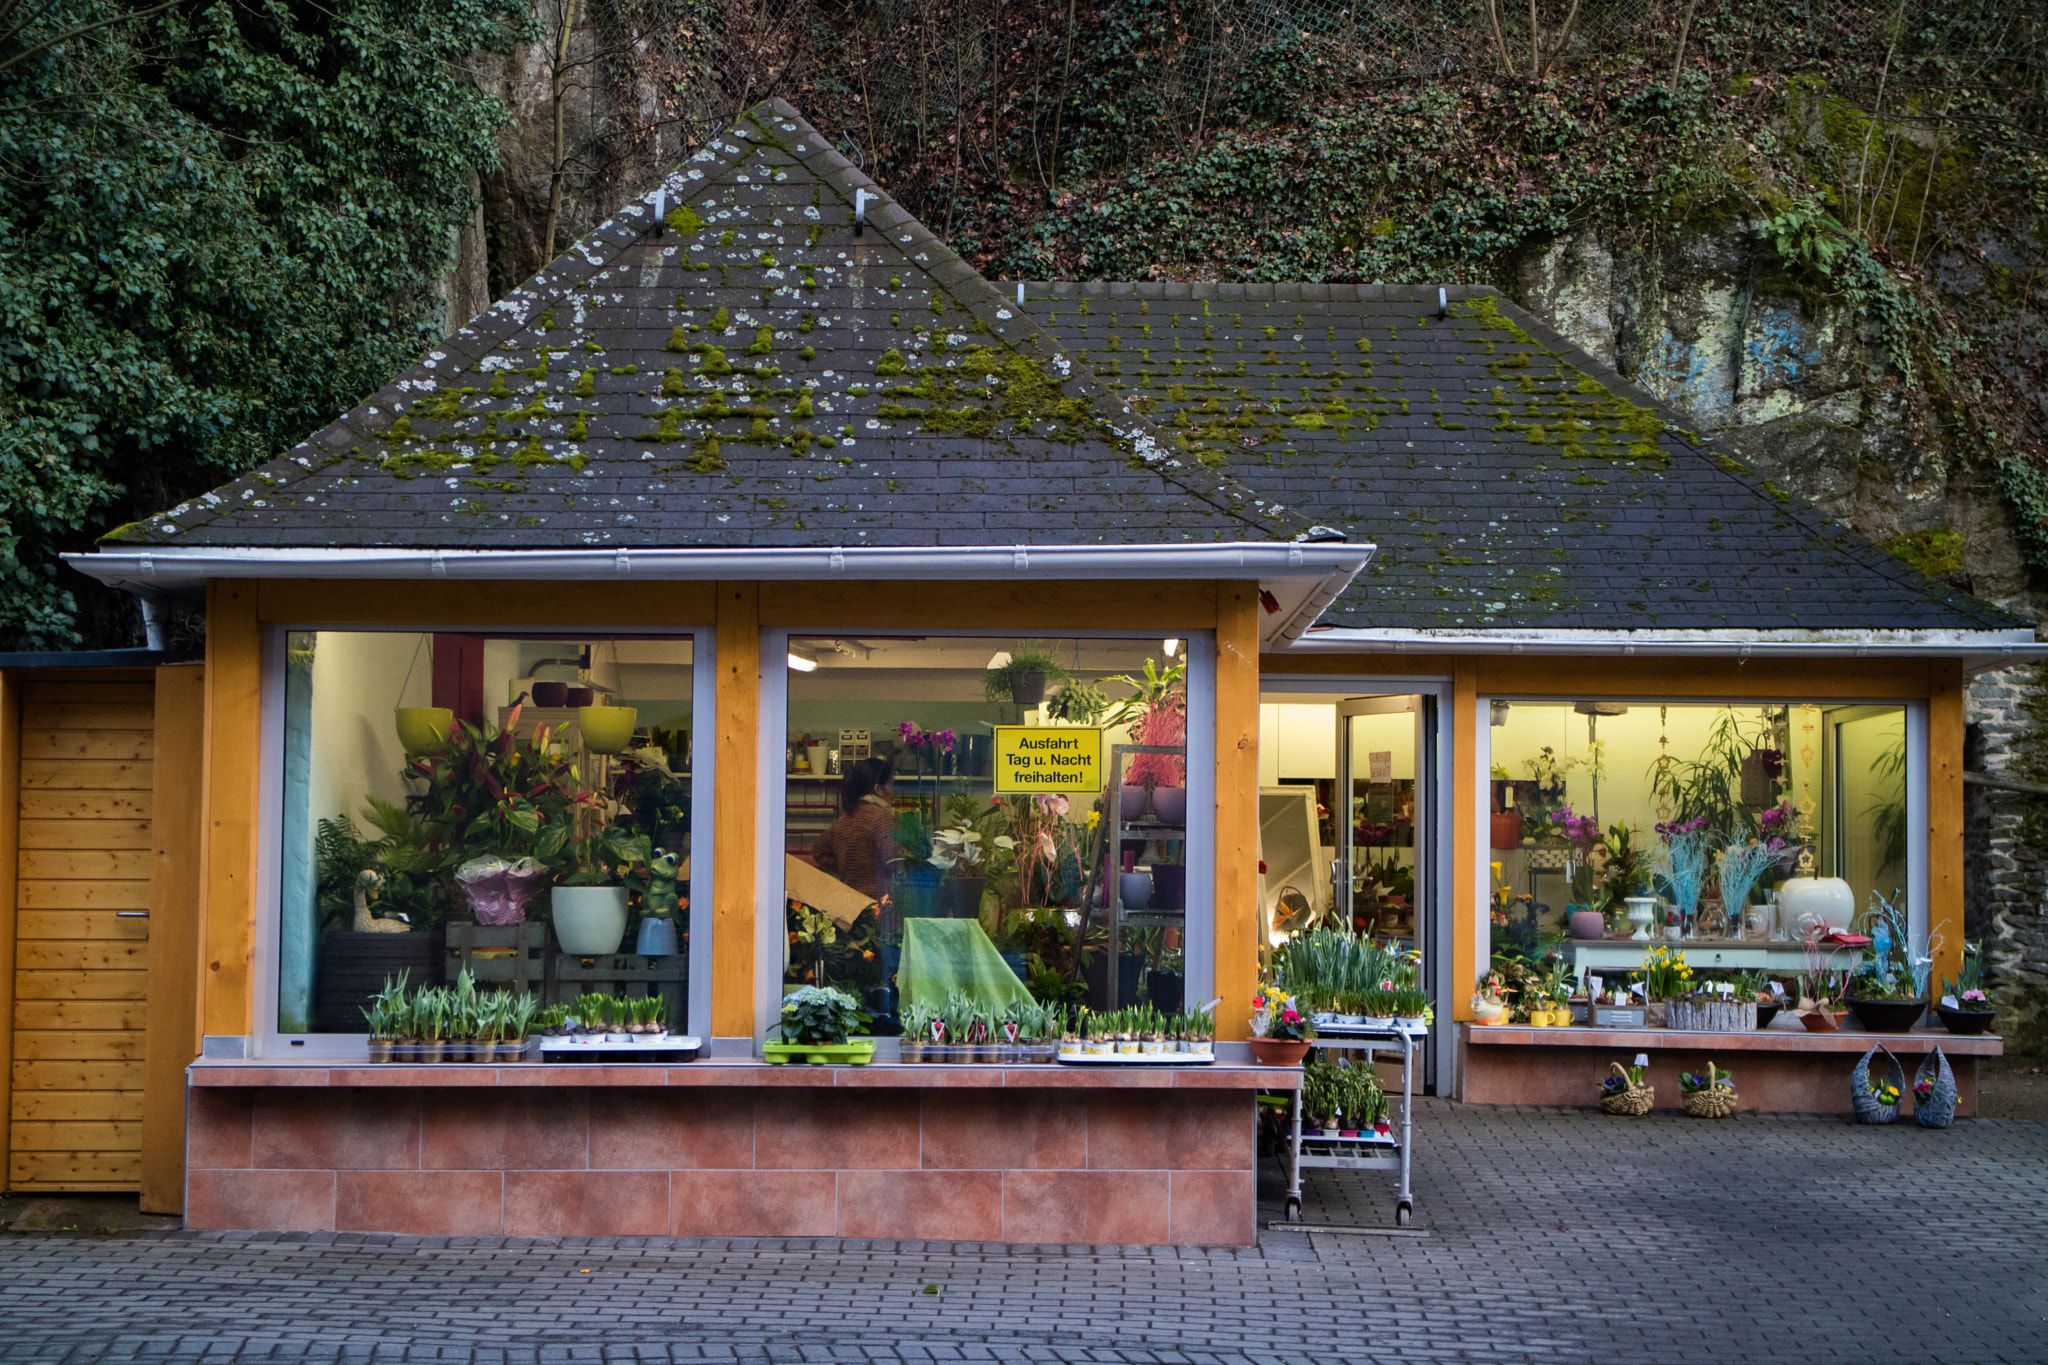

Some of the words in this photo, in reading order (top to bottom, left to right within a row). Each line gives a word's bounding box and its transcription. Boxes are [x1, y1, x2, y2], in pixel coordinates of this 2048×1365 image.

[1019, 737, 1079, 749] Ausfahrt
[1006, 753, 1030, 768] Tag
[1034, 756, 1046, 765] u.
[1051, 753, 1091, 765] Nacht
[1014, 771, 1083, 783] freihalten!
